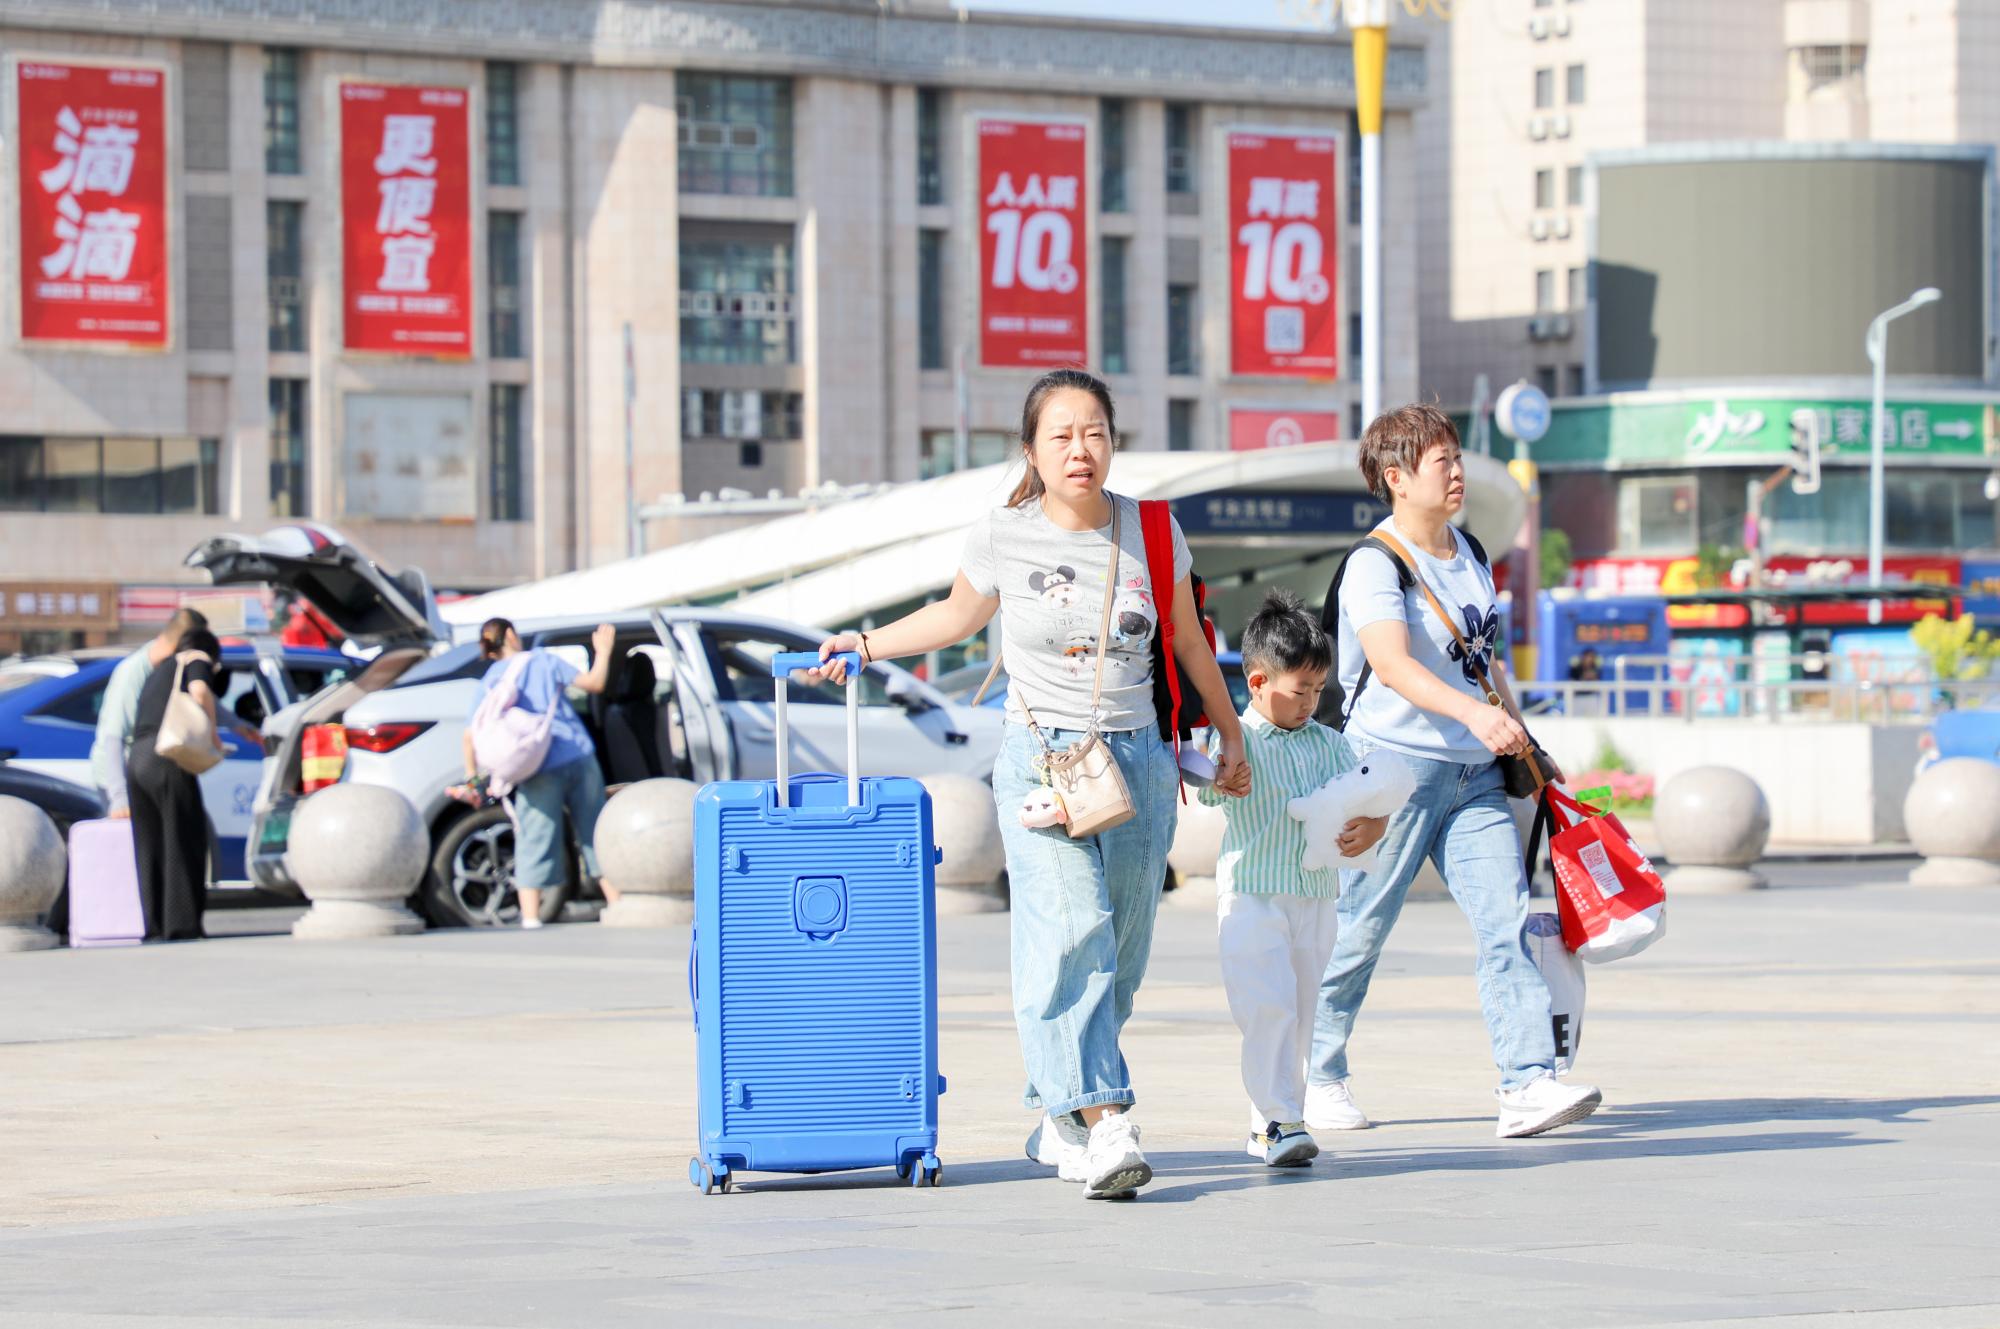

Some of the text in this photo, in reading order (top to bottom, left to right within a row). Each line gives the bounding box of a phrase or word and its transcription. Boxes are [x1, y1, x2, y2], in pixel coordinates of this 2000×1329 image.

[39, 105, 140, 281] 滴滴
[374, 114, 437, 292] 更便宜
